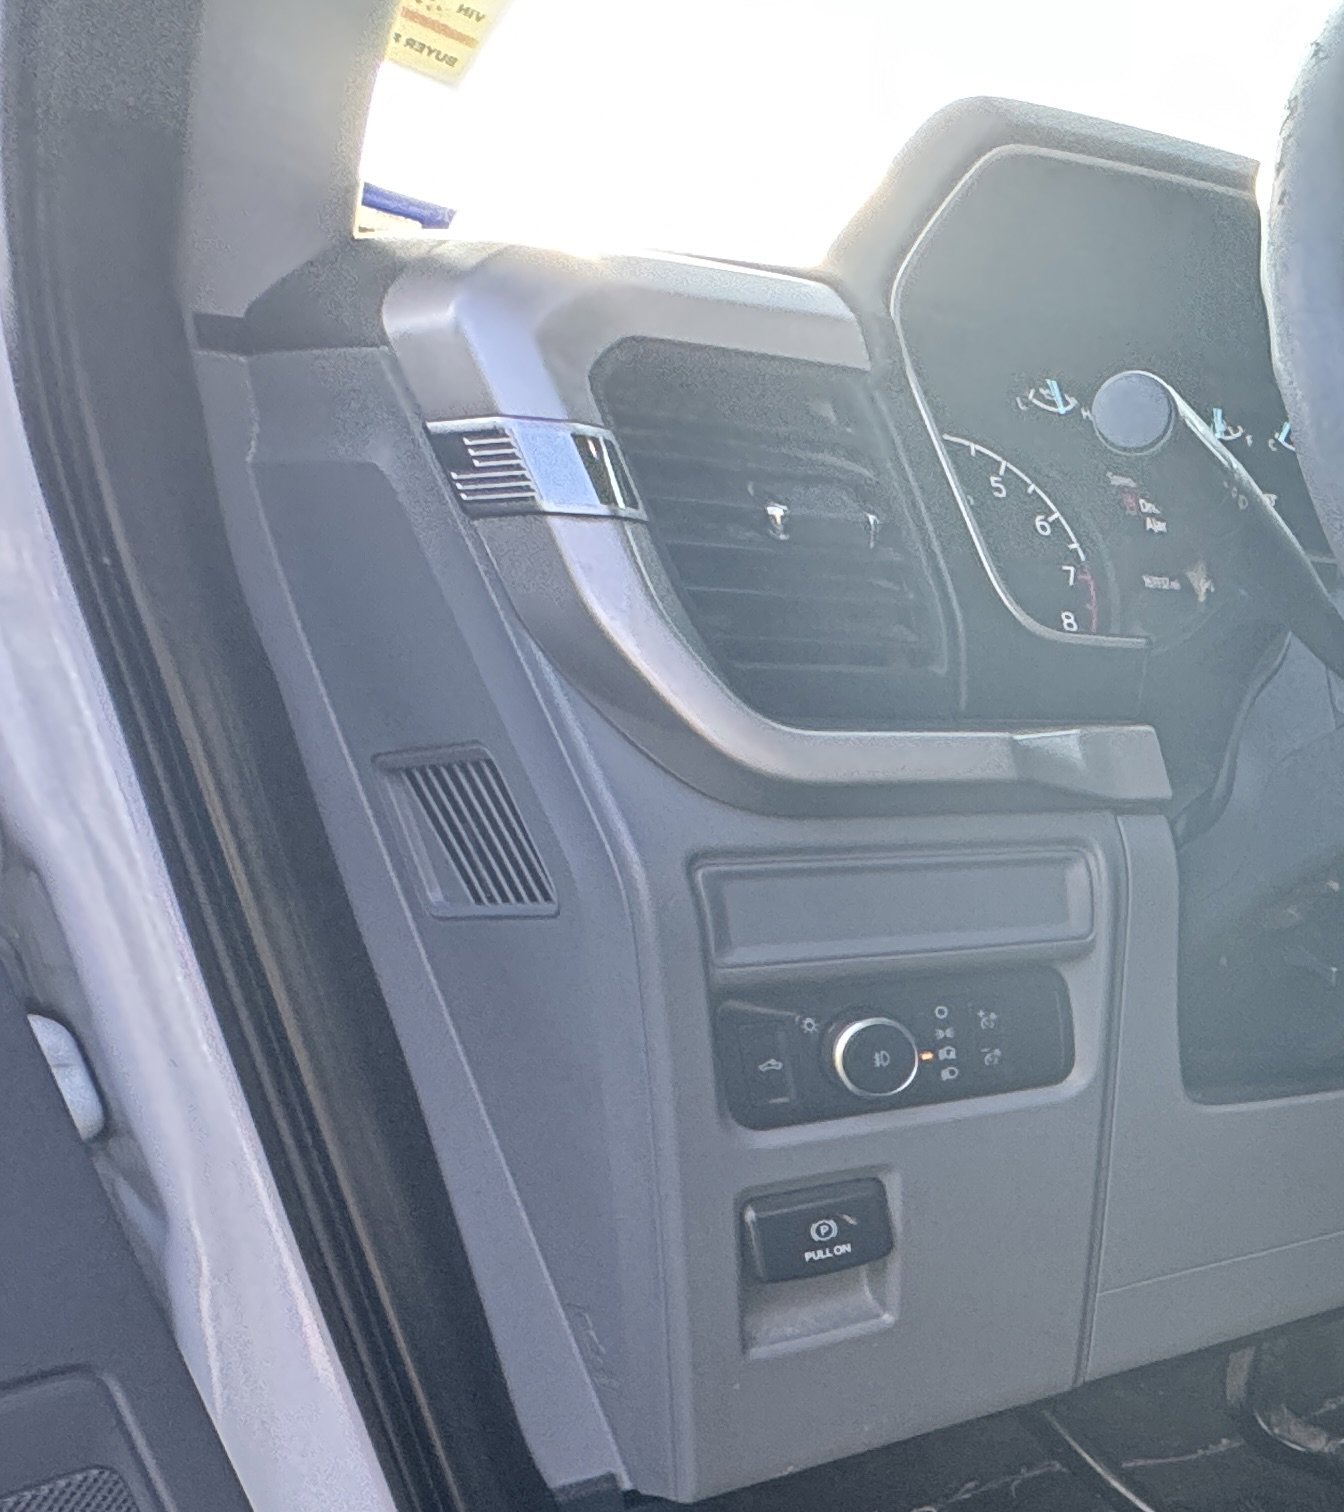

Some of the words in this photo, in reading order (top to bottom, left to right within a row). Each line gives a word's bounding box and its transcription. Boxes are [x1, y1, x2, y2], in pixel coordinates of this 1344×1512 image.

[989, 476, 1007, 498] 5
[1035, 515, 1051, 536] 6
[1061, 565, 1075, 586] 7
[1061, 611, 1078, 632] 8
[804, 1247, 833, 1262] PULL
[833, 1243, 852, 1256] ON
